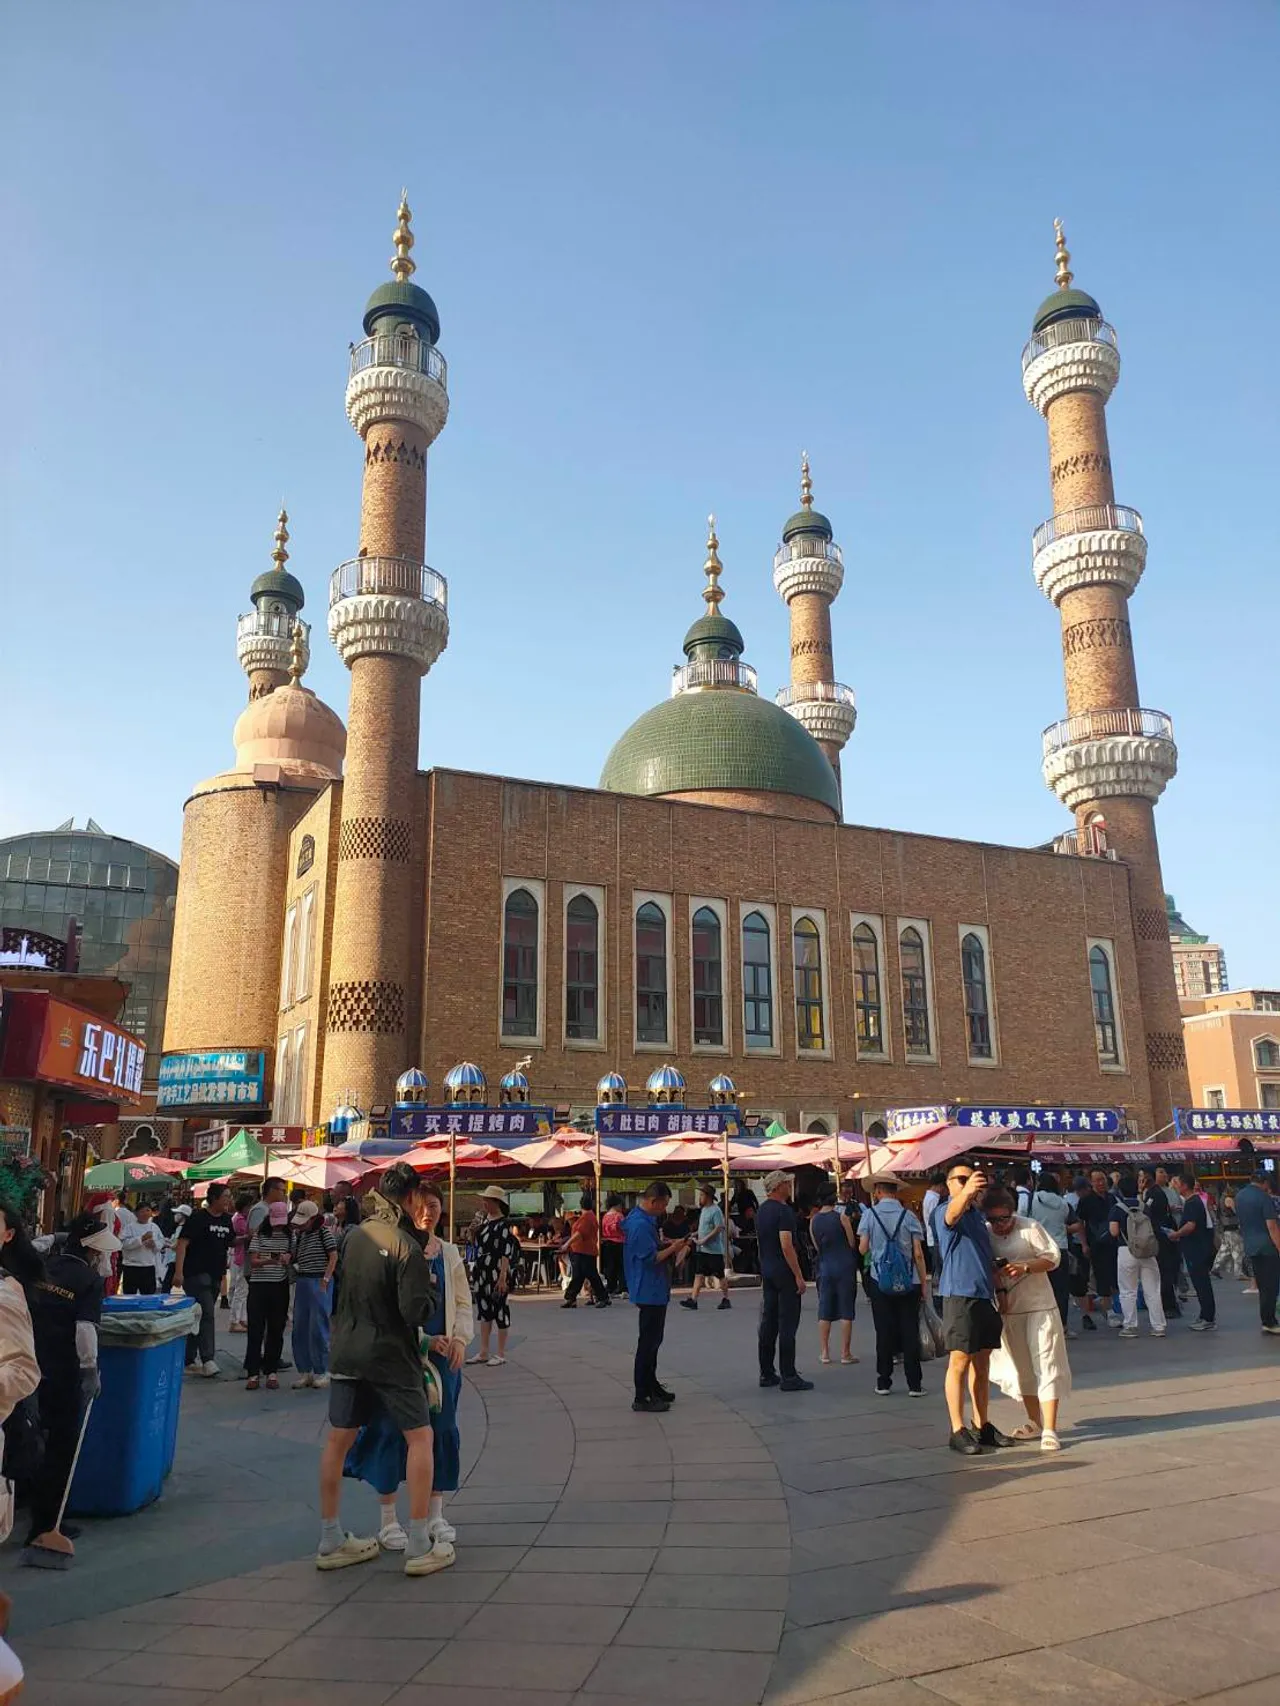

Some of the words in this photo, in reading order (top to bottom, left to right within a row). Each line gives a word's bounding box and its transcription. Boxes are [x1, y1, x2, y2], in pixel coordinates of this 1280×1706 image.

[424, 1114, 524, 1132] 买买提烤肉
[620, 1115, 660, 1131] 肚包肉
[249, 1128, 286, 1142] 干果
